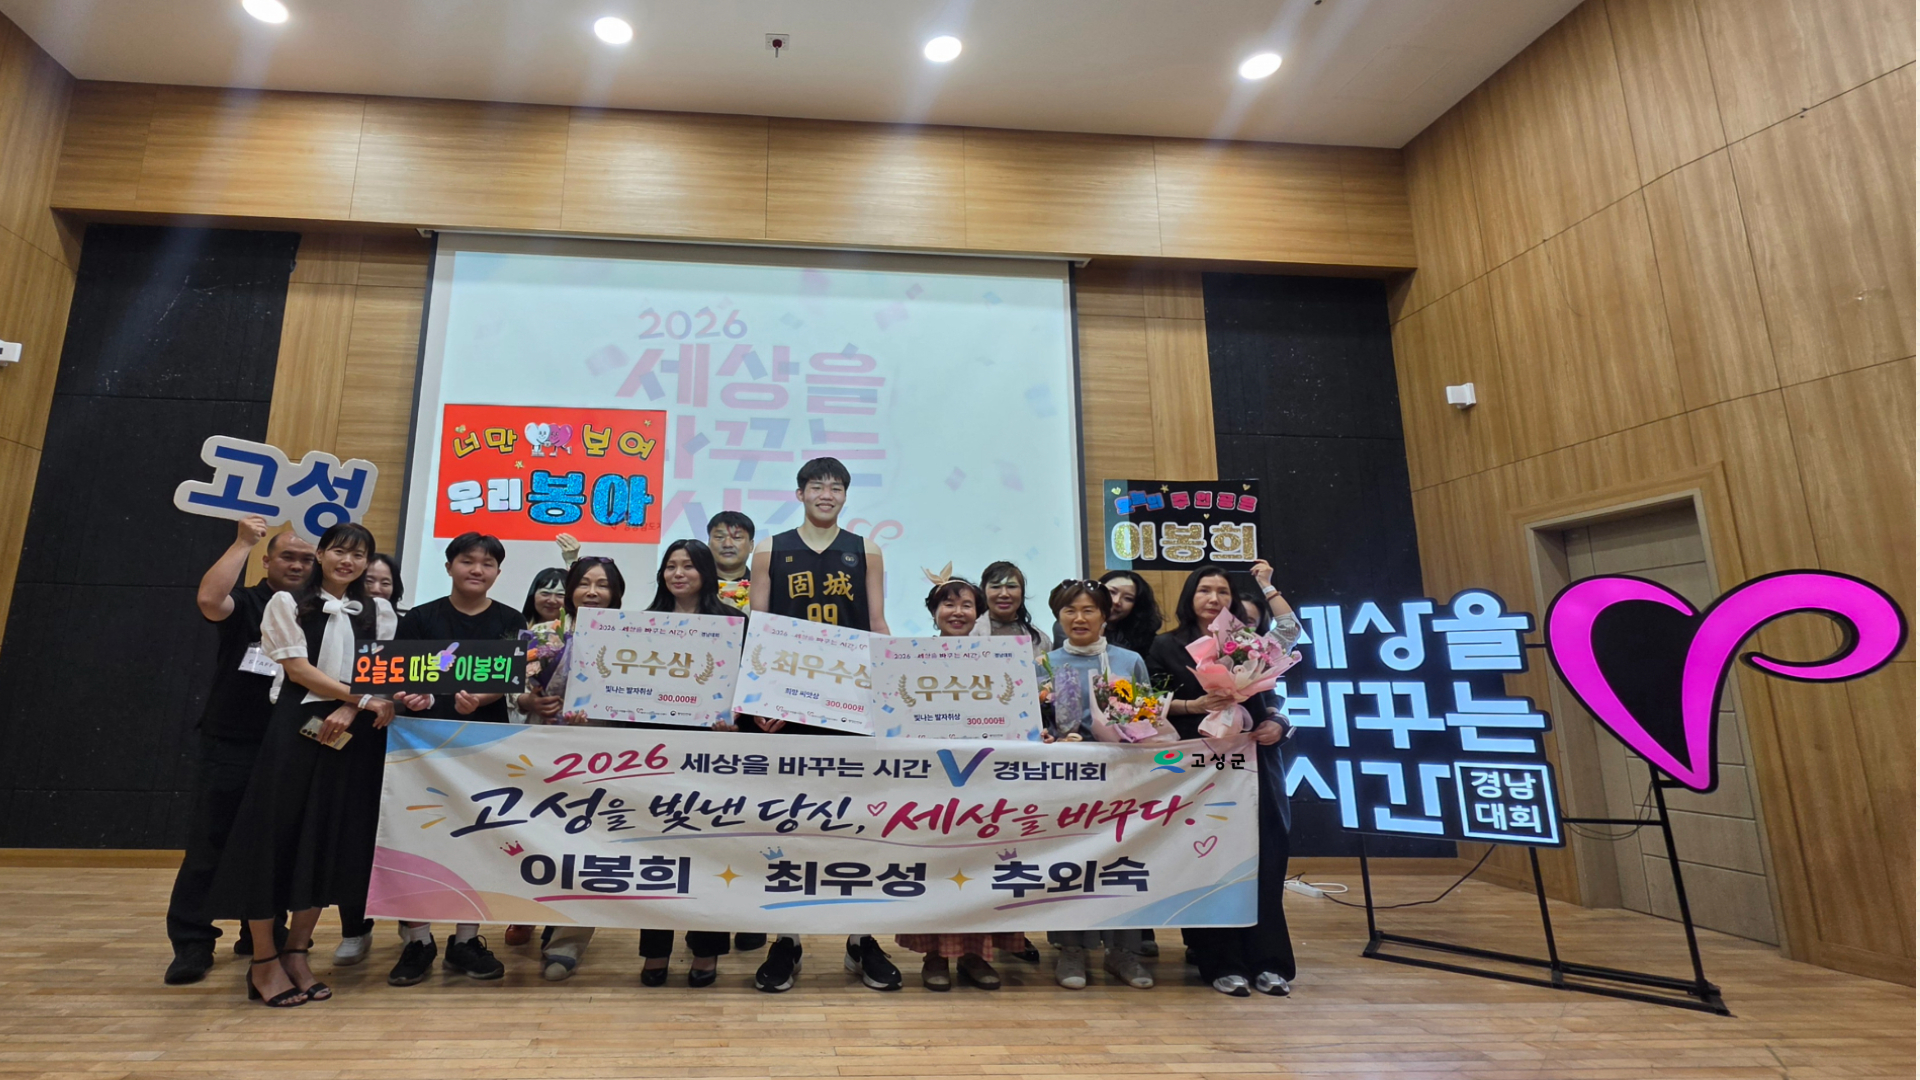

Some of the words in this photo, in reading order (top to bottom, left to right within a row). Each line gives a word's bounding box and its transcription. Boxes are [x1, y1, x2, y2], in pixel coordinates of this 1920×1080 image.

[638, 307, 748, 340] 2026
[615, 343, 886, 415] 세상을
[453, 427, 518, 458] 너만
[582, 424, 656, 460] 보여
[188, 445, 368, 538] 고성
[447, 477, 523, 514] 우리
[526, 470, 654, 527] 봉아
[1111, 521, 1257, 562] 이봉희
[787, 570, 854, 601] 固城
[599, 624, 616, 632] 2026
[621, 625, 643, 633] 세상을
[644, 627, 666, 635] 바꾸는
[807, 603, 838, 626] 99
[771, 628, 788, 637] 2026
[1272, 592, 1529, 671] 세상을
[354, 655, 405, 685] 오늘도
[409, 653, 442, 683] 따봉
[454, 655, 512, 683] 이봉희
[611, 648, 695, 679] 우수상
[605, 685, 625, 694] 빛나는
[658, 693, 697, 704] 300,000원
[914, 674, 994, 702] 우수상
[825, 699, 865, 713] 300,000원
[914, 714, 934, 722] 빛나는
[966, 717, 1006, 725] 300,000원
[1276, 681, 1546, 753] 바꾸는
[543, 743, 670, 784] 2026
[679, 753, 769, 776] 세상을
[778, 756, 865, 778] 바꾸는
[873, 759, 932, 779] 시간
[993, 761, 1107, 782] 경남대회
[1286, 756, 1451, 835] 시간
[1470, 771, 1537, 800] 경남
[449, 787, 636, 839] 고성을
[648, 791, 748, 834] 빛낸
[757, 793, 865, 835] 당신,
[881, 797, 1049, 839] 세상을
[1474, 803, 1542, 833] 대회
[520, 853, 691, 895] 이봉희
[765, 860, 926, 898] 최우성
[992, 856, 1150, 898] 추외숙
